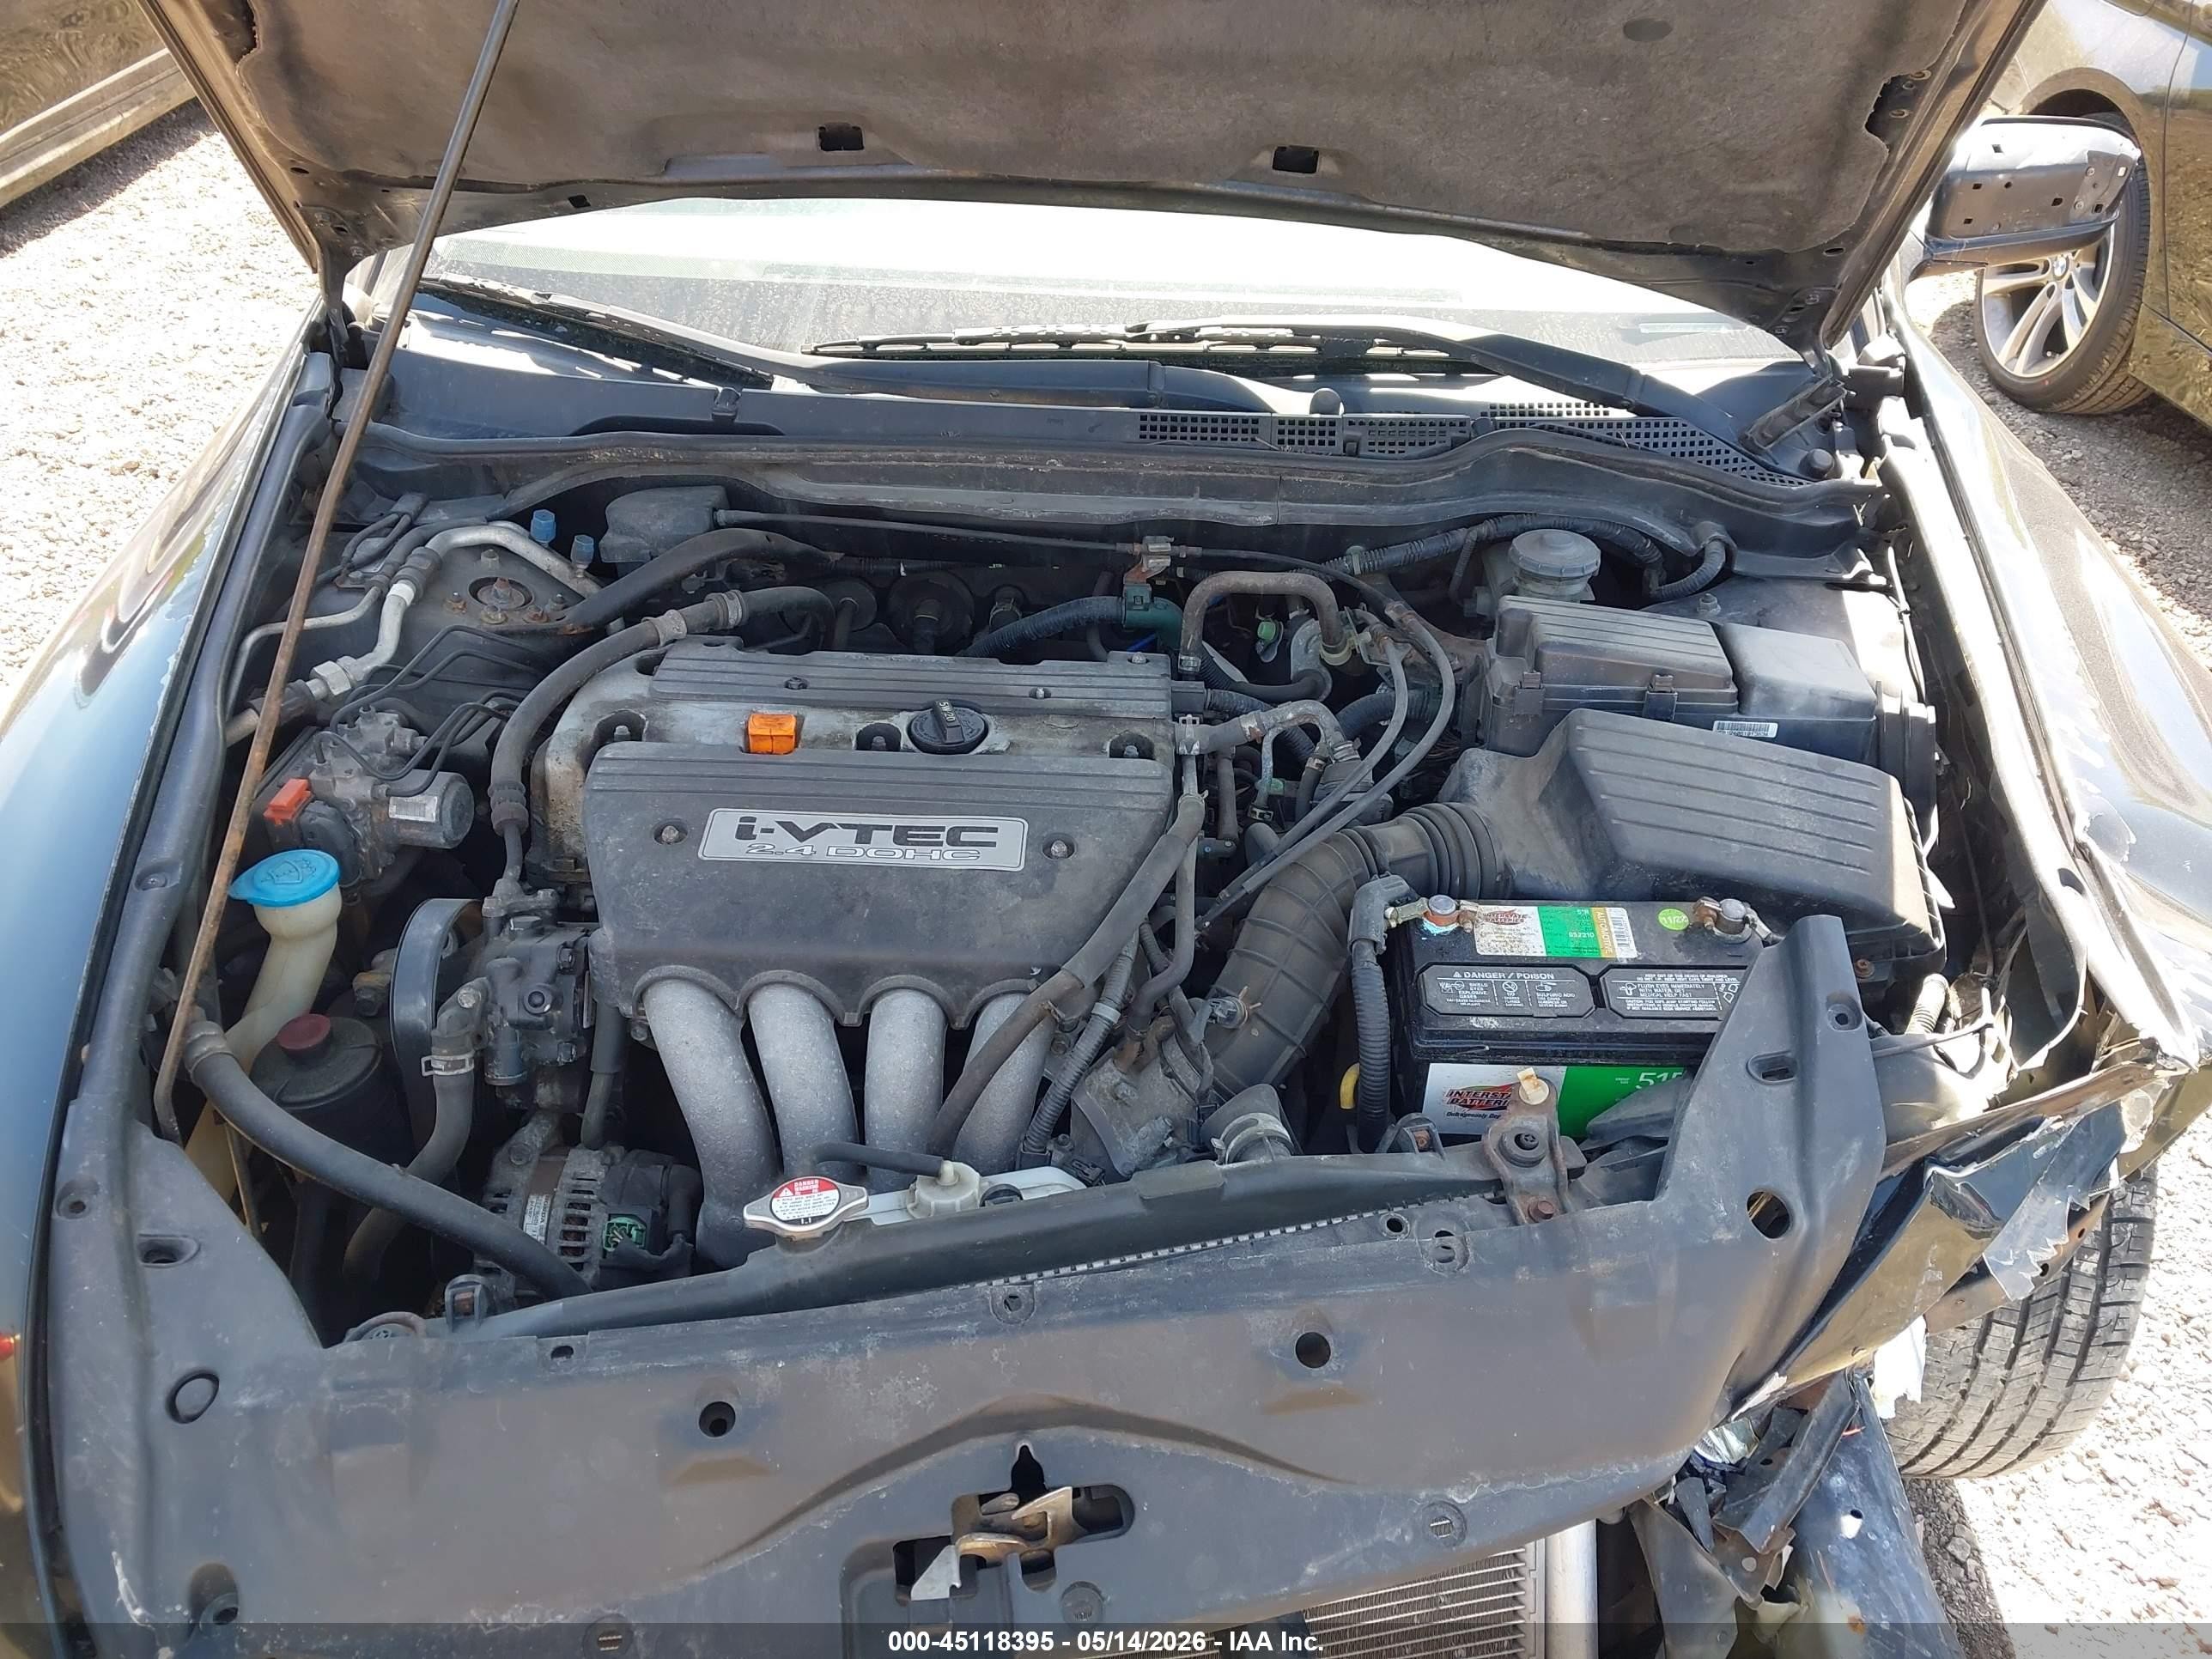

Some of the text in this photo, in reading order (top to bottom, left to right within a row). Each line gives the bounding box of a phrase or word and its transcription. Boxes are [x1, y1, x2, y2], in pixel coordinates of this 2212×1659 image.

[735, 816, 999, 848] i-VTEC
[747, 843, 981, 860] 2.4 DOHC
[1596, 910, 1613, 955] AUTOMOTIVE
[1448, 1097, 1510, 1107] BATTERI
